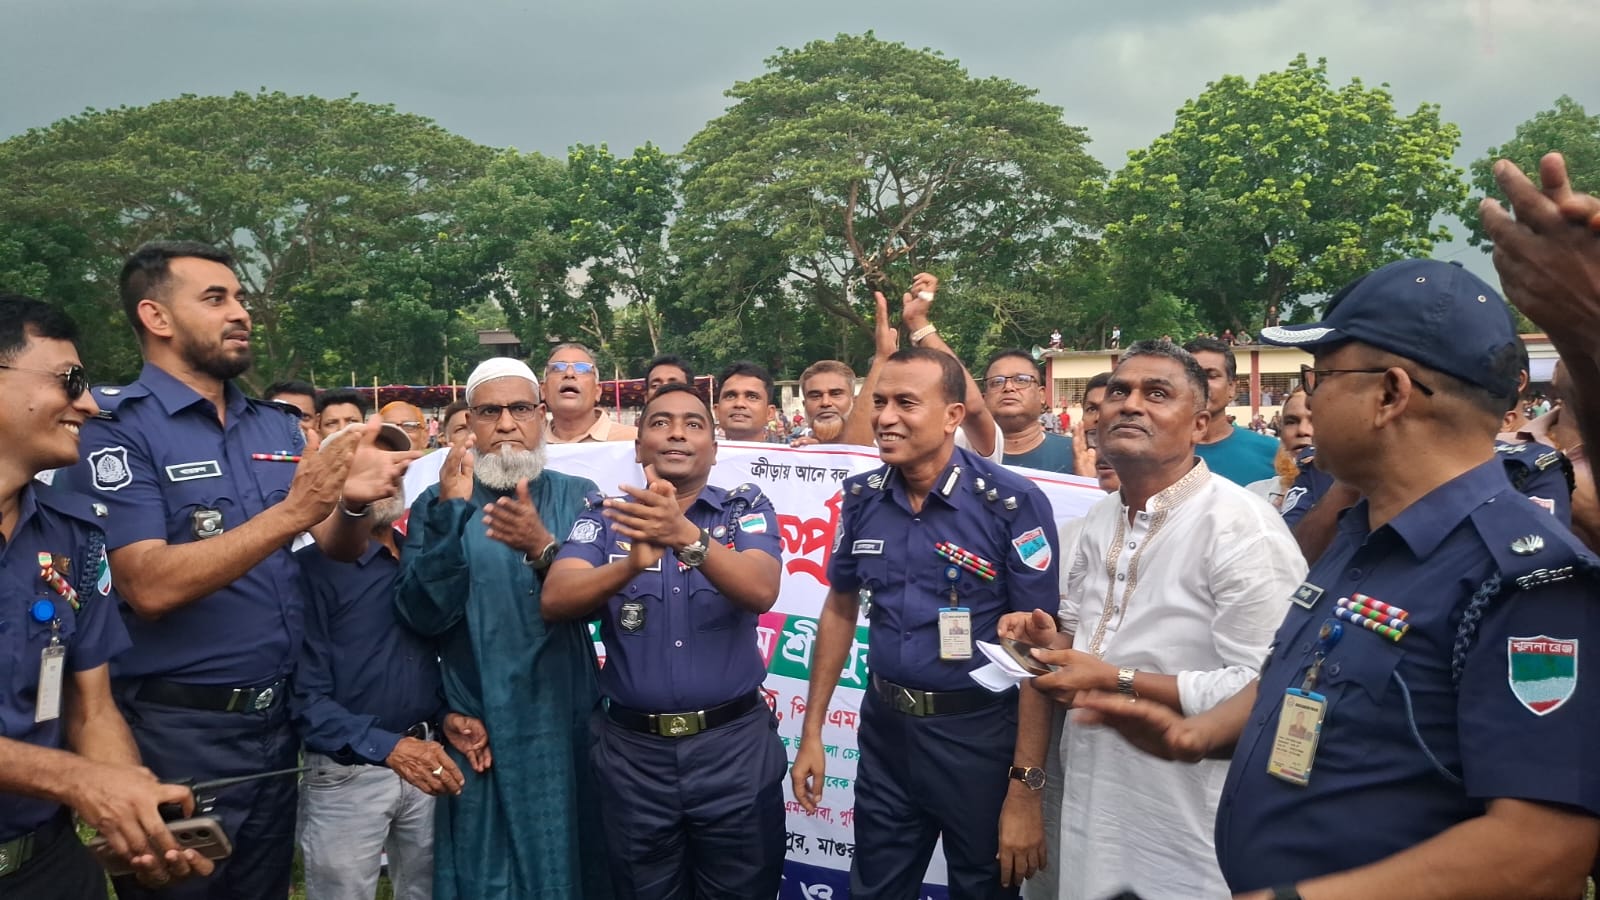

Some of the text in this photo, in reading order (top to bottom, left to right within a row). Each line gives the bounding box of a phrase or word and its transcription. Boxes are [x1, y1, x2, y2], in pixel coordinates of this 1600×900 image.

[750, 457, 850, 483] ক্রীড়ায় আনে বল
[1513, 641, 1547, 653] খুলনা
